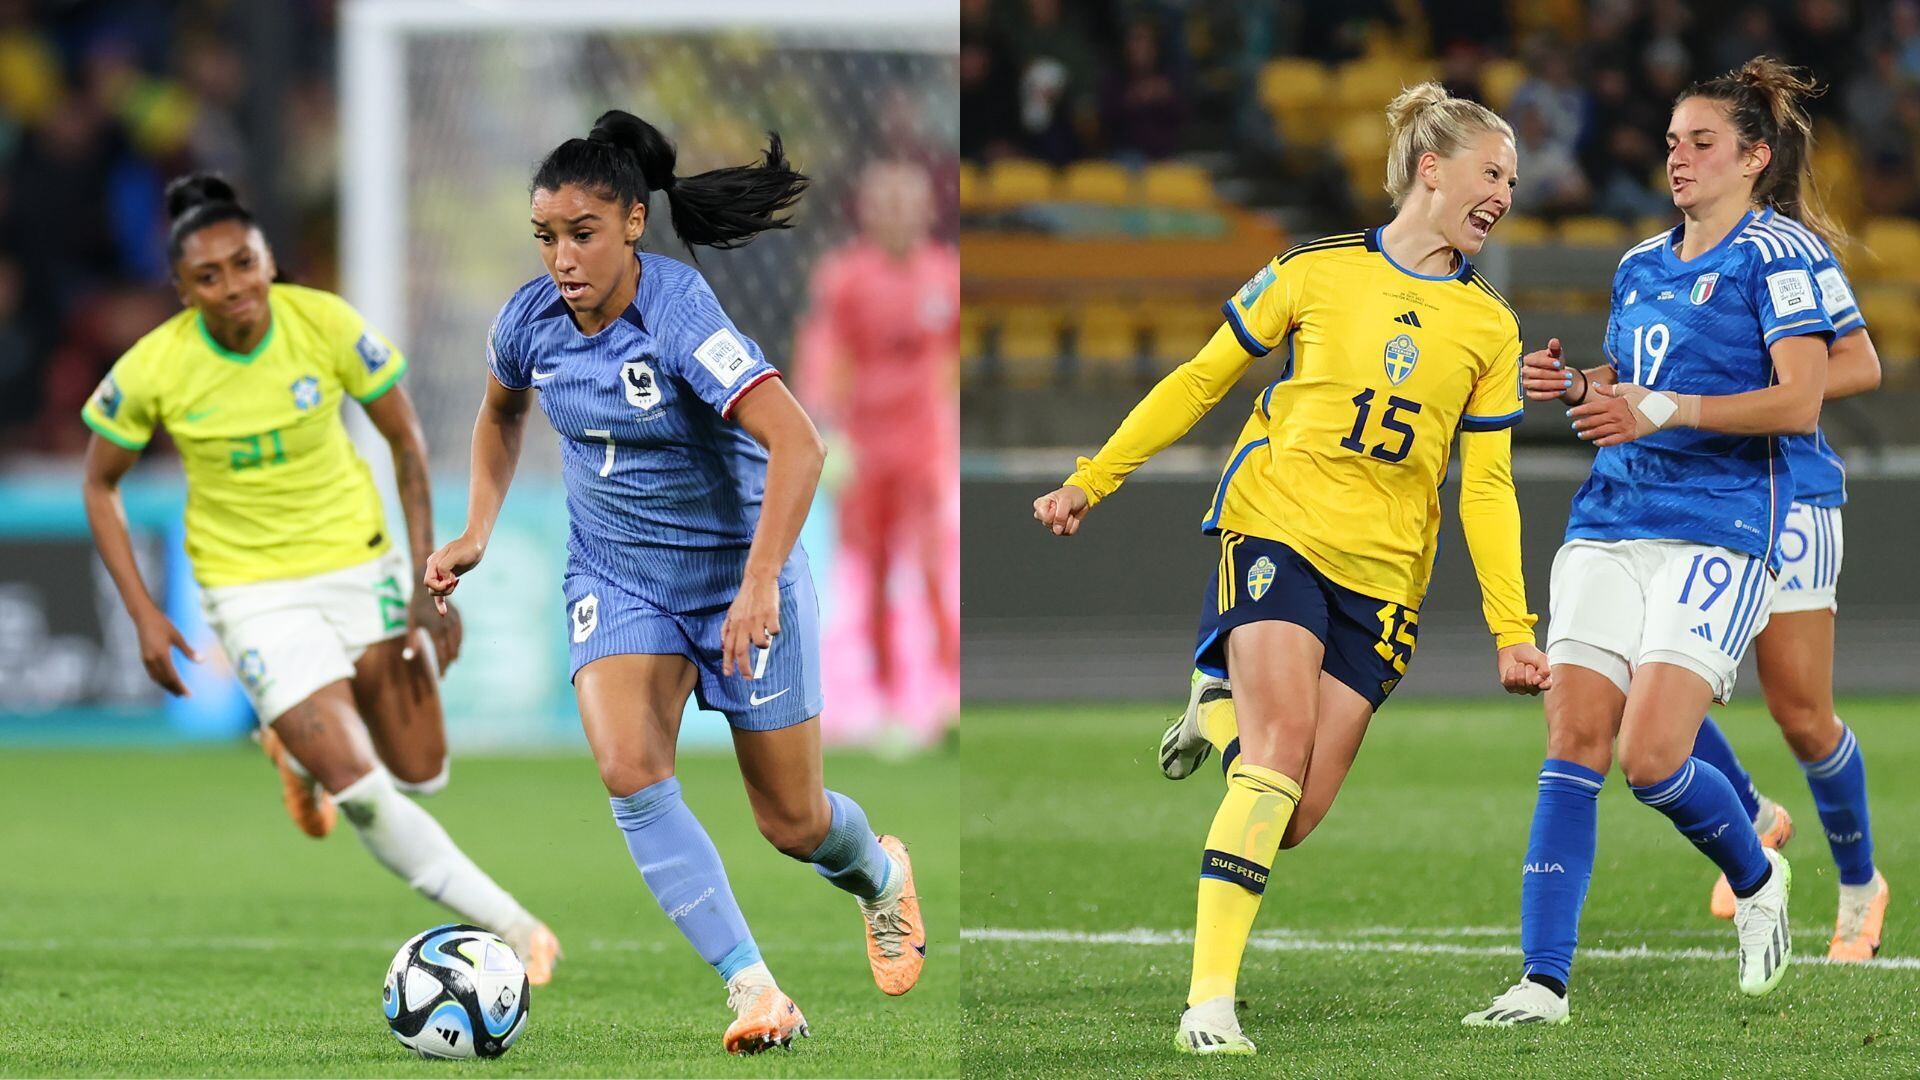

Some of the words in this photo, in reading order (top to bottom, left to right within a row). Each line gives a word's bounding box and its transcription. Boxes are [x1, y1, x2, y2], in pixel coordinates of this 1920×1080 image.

[1633, 324, 1670, 385] 19
[584, 428, 616, 477] 7
[1340, 387, 1422, 463] 15
[1677, 554, 1733, 611] 19
[1373, 602, 1419, 676] 15
